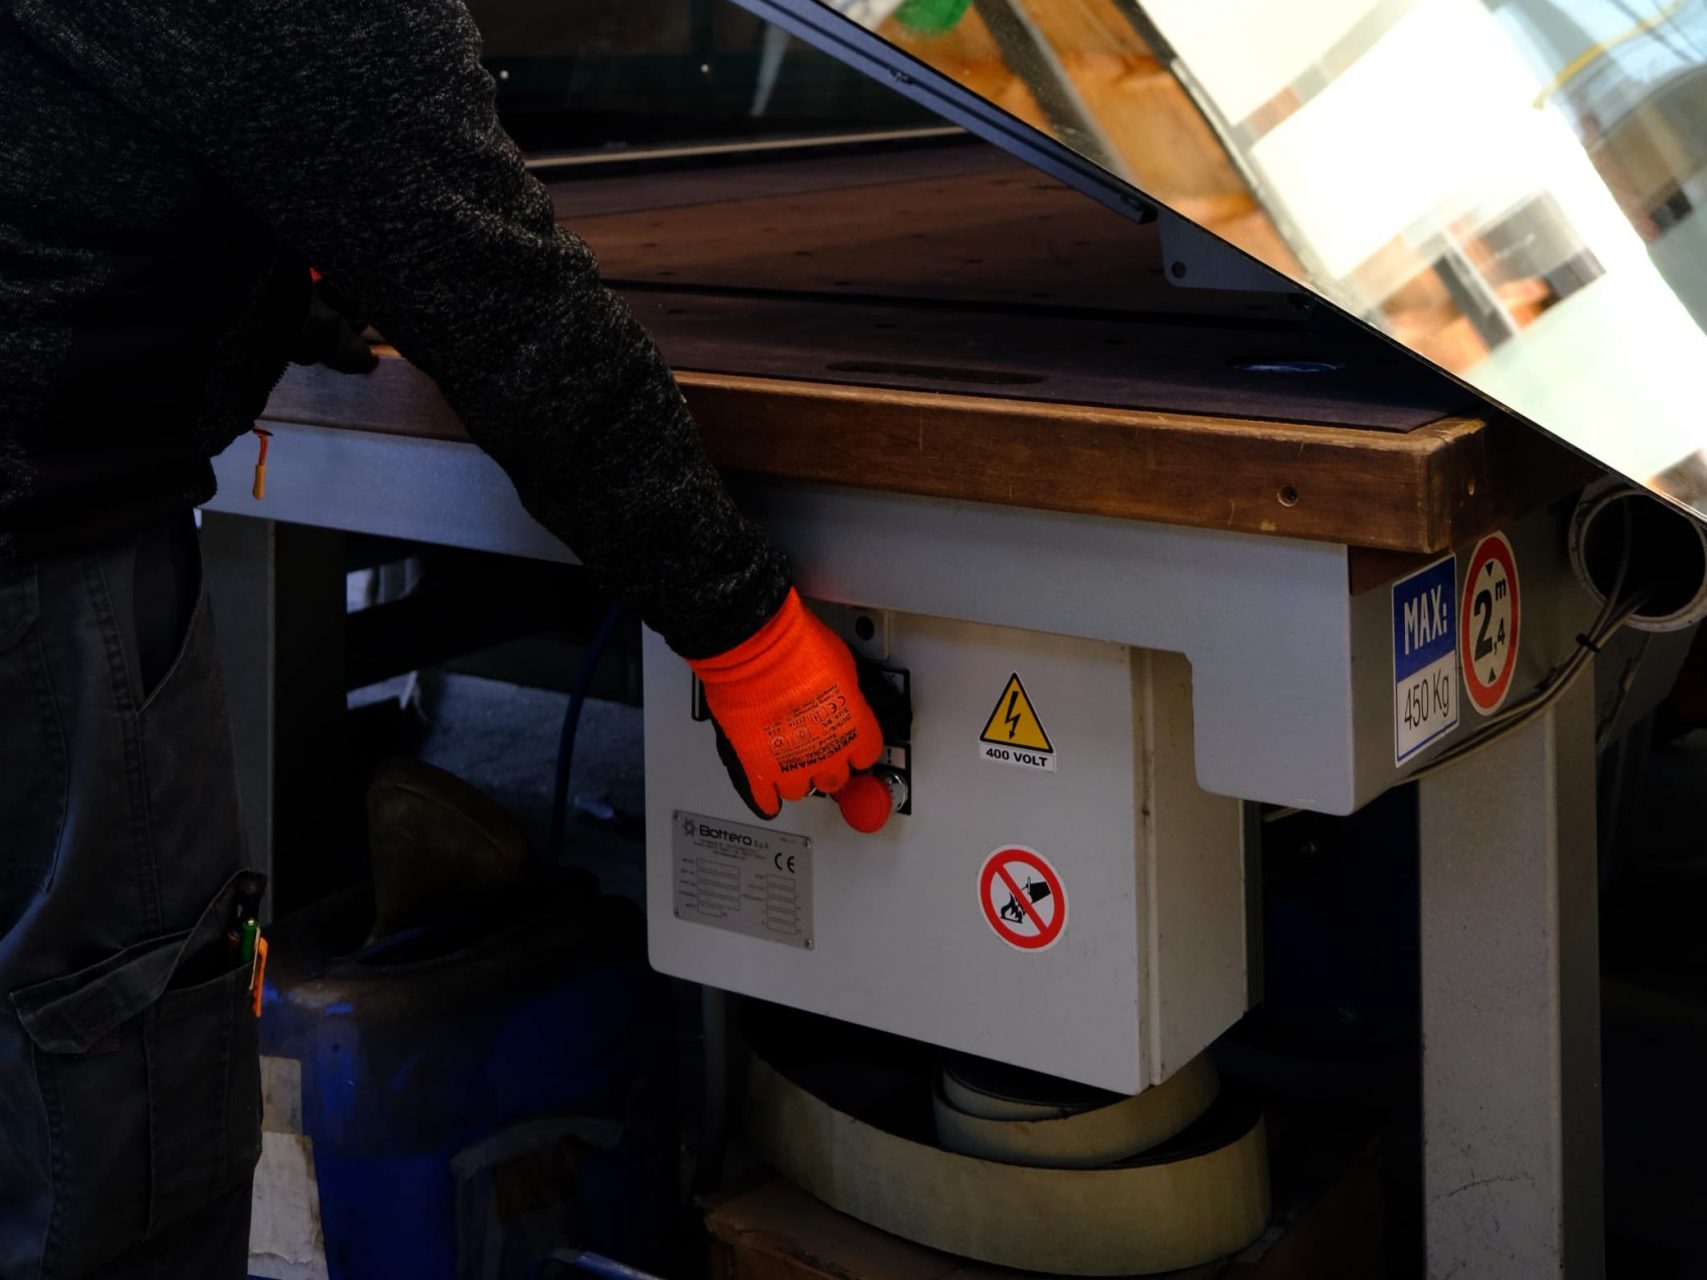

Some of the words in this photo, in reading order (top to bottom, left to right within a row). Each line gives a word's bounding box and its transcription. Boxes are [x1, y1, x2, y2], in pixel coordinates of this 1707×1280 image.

[1495, 578, 1507, 601] m
[1404, 678, 1428, 731] 450
[1433, 668, 1450, 718] Kg
[986, 748, 1010, 760] 400
[1013, 752, 1048, 767] VOLT
[699, 824, 752, 846] Bottero
[774, 852, 795, 874] CE
